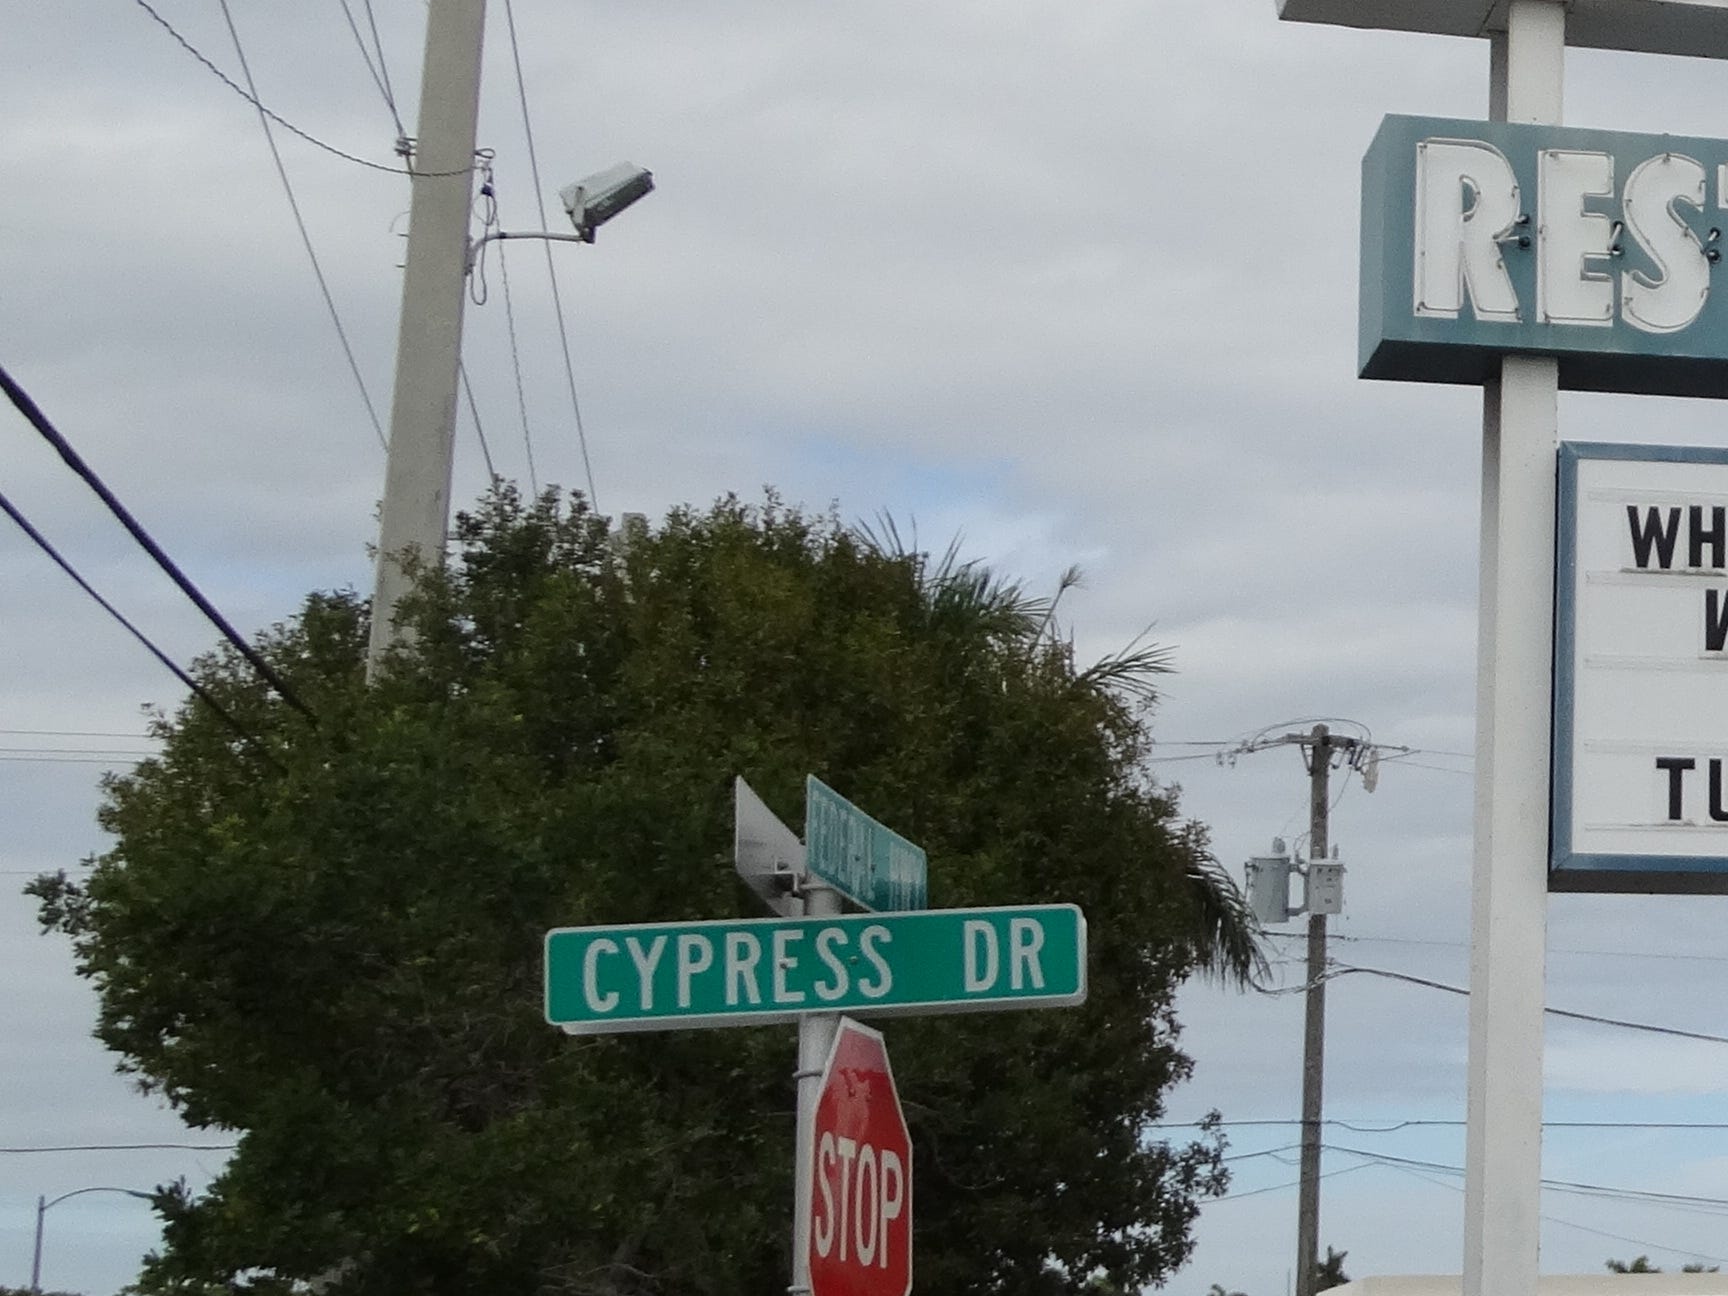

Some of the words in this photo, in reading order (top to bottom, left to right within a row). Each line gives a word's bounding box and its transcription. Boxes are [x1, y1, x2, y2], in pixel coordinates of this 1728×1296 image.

[582, 924, 894, 1012] CYPRESS
[964, 917, 1046, 993] DR
[815, 1131, 903, 1269] STOP
